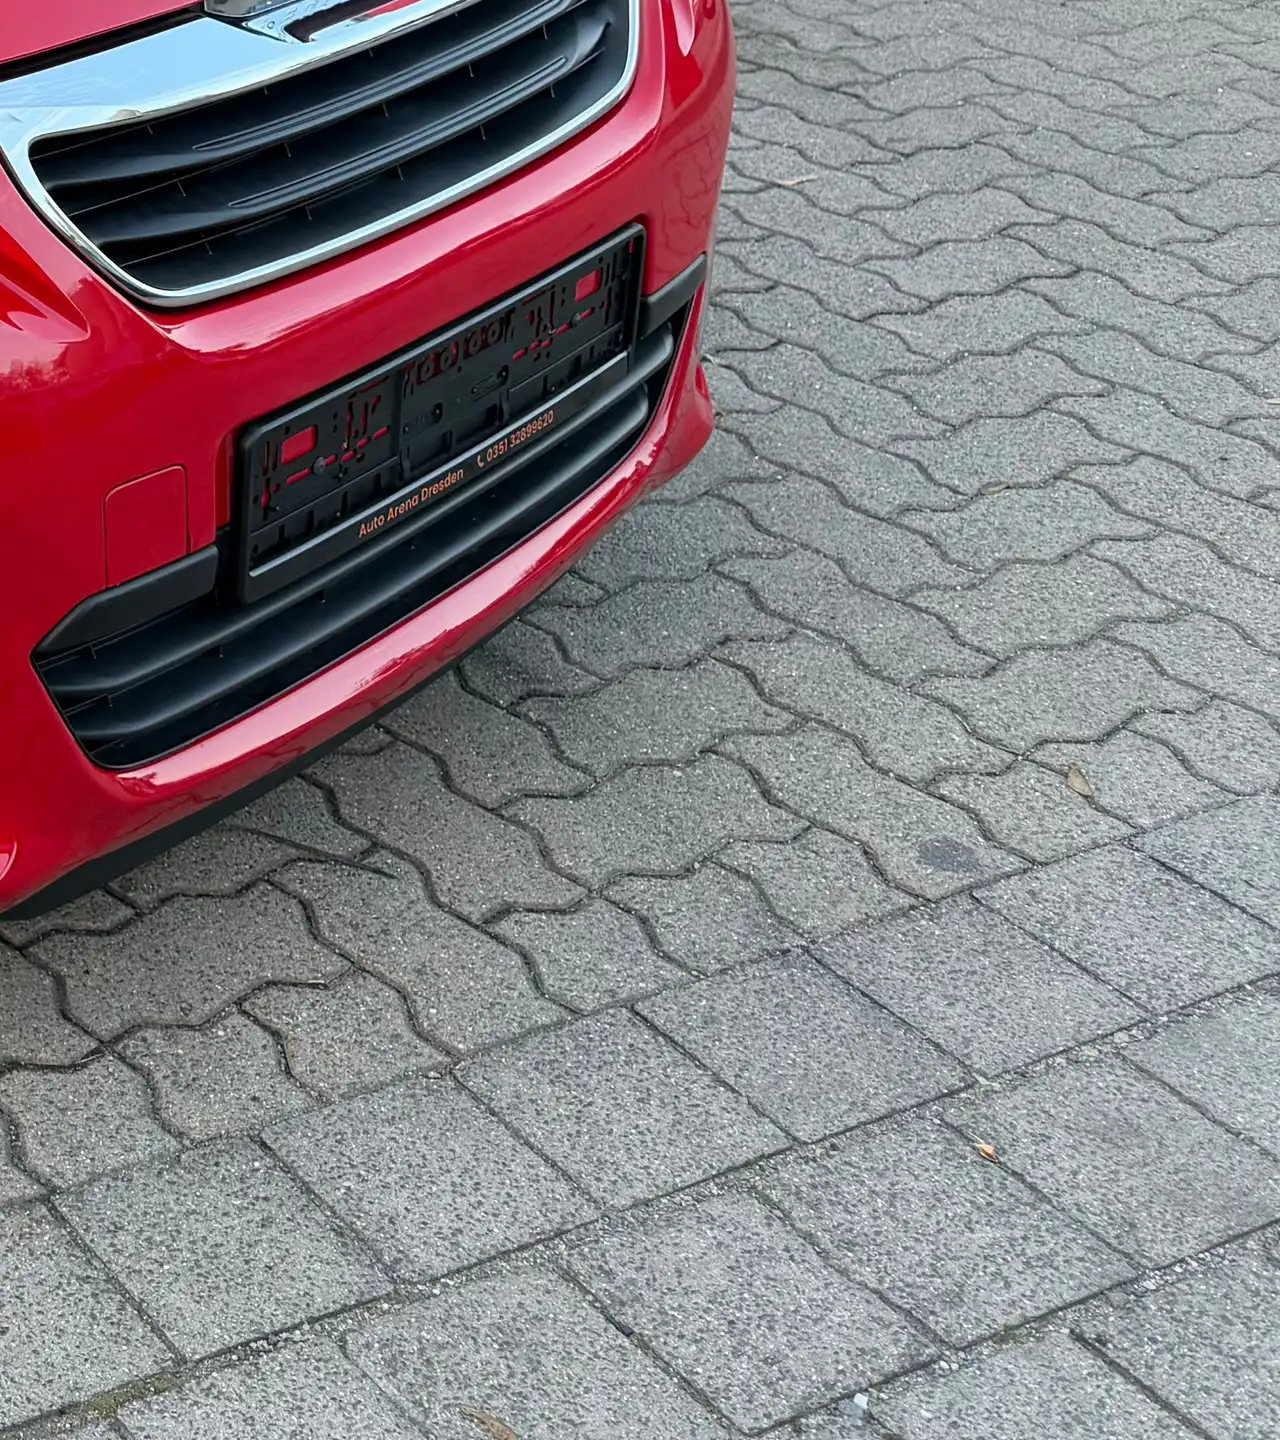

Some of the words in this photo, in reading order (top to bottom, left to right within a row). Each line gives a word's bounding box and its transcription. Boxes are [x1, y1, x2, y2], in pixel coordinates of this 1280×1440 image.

[358, 513, 385, 539] Auto
[386, 495, 419, 520] Arena
[420, 467, 465, 502] Dresden
[486, 438, 509, 462] 0351
[509, 409, 555, 448] 32899620
